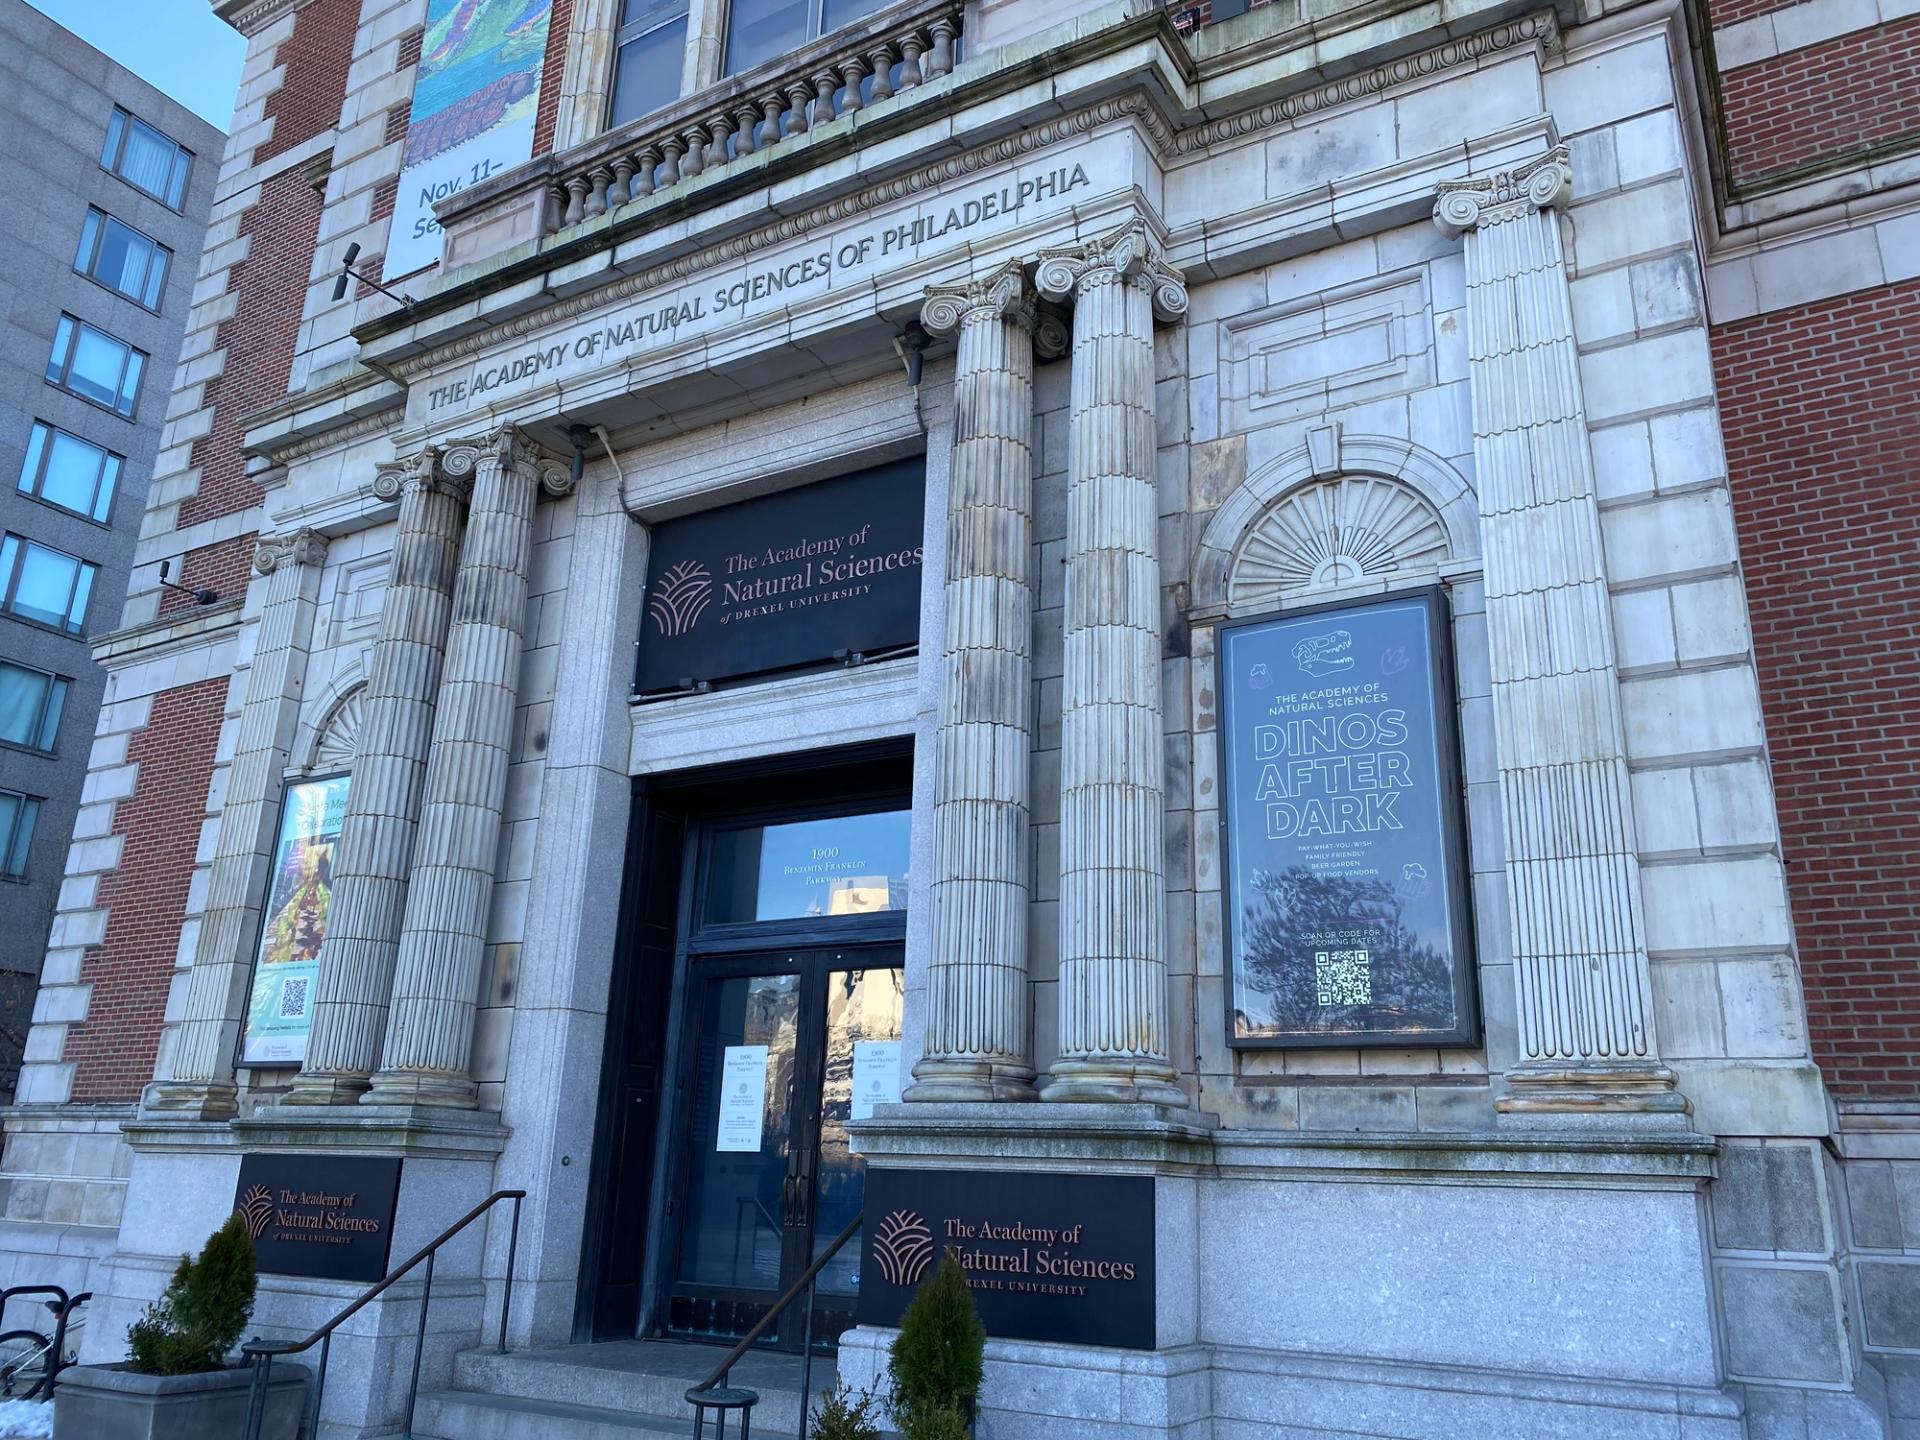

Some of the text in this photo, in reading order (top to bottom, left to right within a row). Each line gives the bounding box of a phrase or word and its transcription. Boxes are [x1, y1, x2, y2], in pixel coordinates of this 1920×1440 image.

[419, 176, 462, 208] Nov.
[428, 162, 1090, 411] THE ACADEMY OF NATURAL SCIENCES OF PHILADELPHIA
[724, 524, 871, 574] The Academy of
[721, 546, 924, 605] Natural Sciences
[720, 584, 873, 624] of DREXEL UNIVERSITY
[1269, 693, 1389, 717] NATURAL SCIENCES
[1275, 682, 1381, 705] THE ACADEMY OF
[1254, 709, 1409, 761] DINOS
[1255, 751, 1414, 801] AFTER
[1266, 792, 1404, 840] DARK
[812, 847, 839, 861] 1900
[1305, 850, 1366, 861] FAMILY FRIENDLY
[1311, 860, 1361, 870] BEER GARDEN
[1323, 870, 1343, 878] FOOD
[1344, 868, 1380, 877] VENDORS
[1300, 932, 1323, 940] SCAN
[1339, 930, 1362, 938] CODE
[1305, 937, 1377, 947] UPCOMING DATES
[279, 1189, 356, 1210] The Academy of
[275, 1209, 380, 1233] Natural Sciences
[944, 1218, 1082, 1247] The Academy of
[1036, 1250, 1135, 1280] Sciences
[1009, 1281, 1087, 1296] UNIVERSITY
